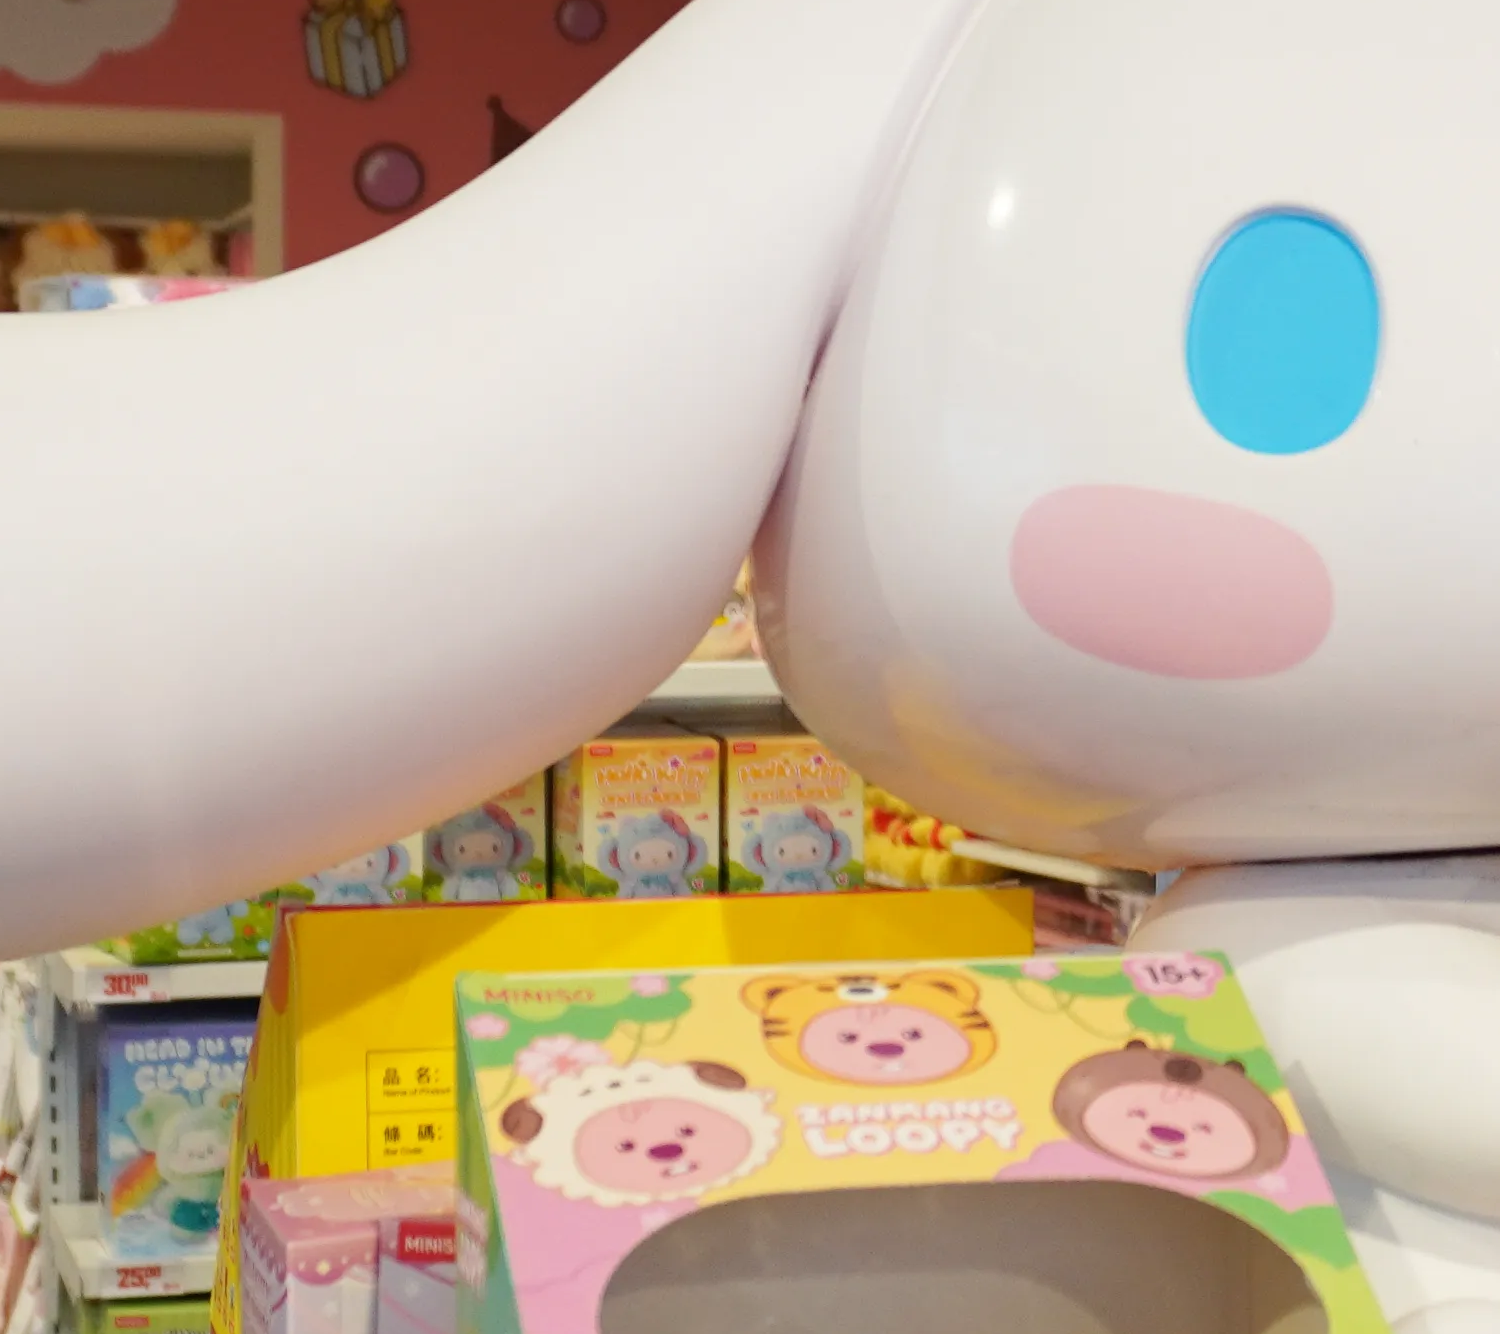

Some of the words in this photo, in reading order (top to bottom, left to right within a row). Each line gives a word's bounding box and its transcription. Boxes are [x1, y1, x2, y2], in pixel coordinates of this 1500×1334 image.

[1145, 965, 1206, 985] 15+
[484, 987, 595, 1004] MINISO
[799, 1098, 1018, 1125] ZANMANG
[805, 1119, 1023, 1158] LOOPY
[405, 1236, 457, 1255] MINIS
